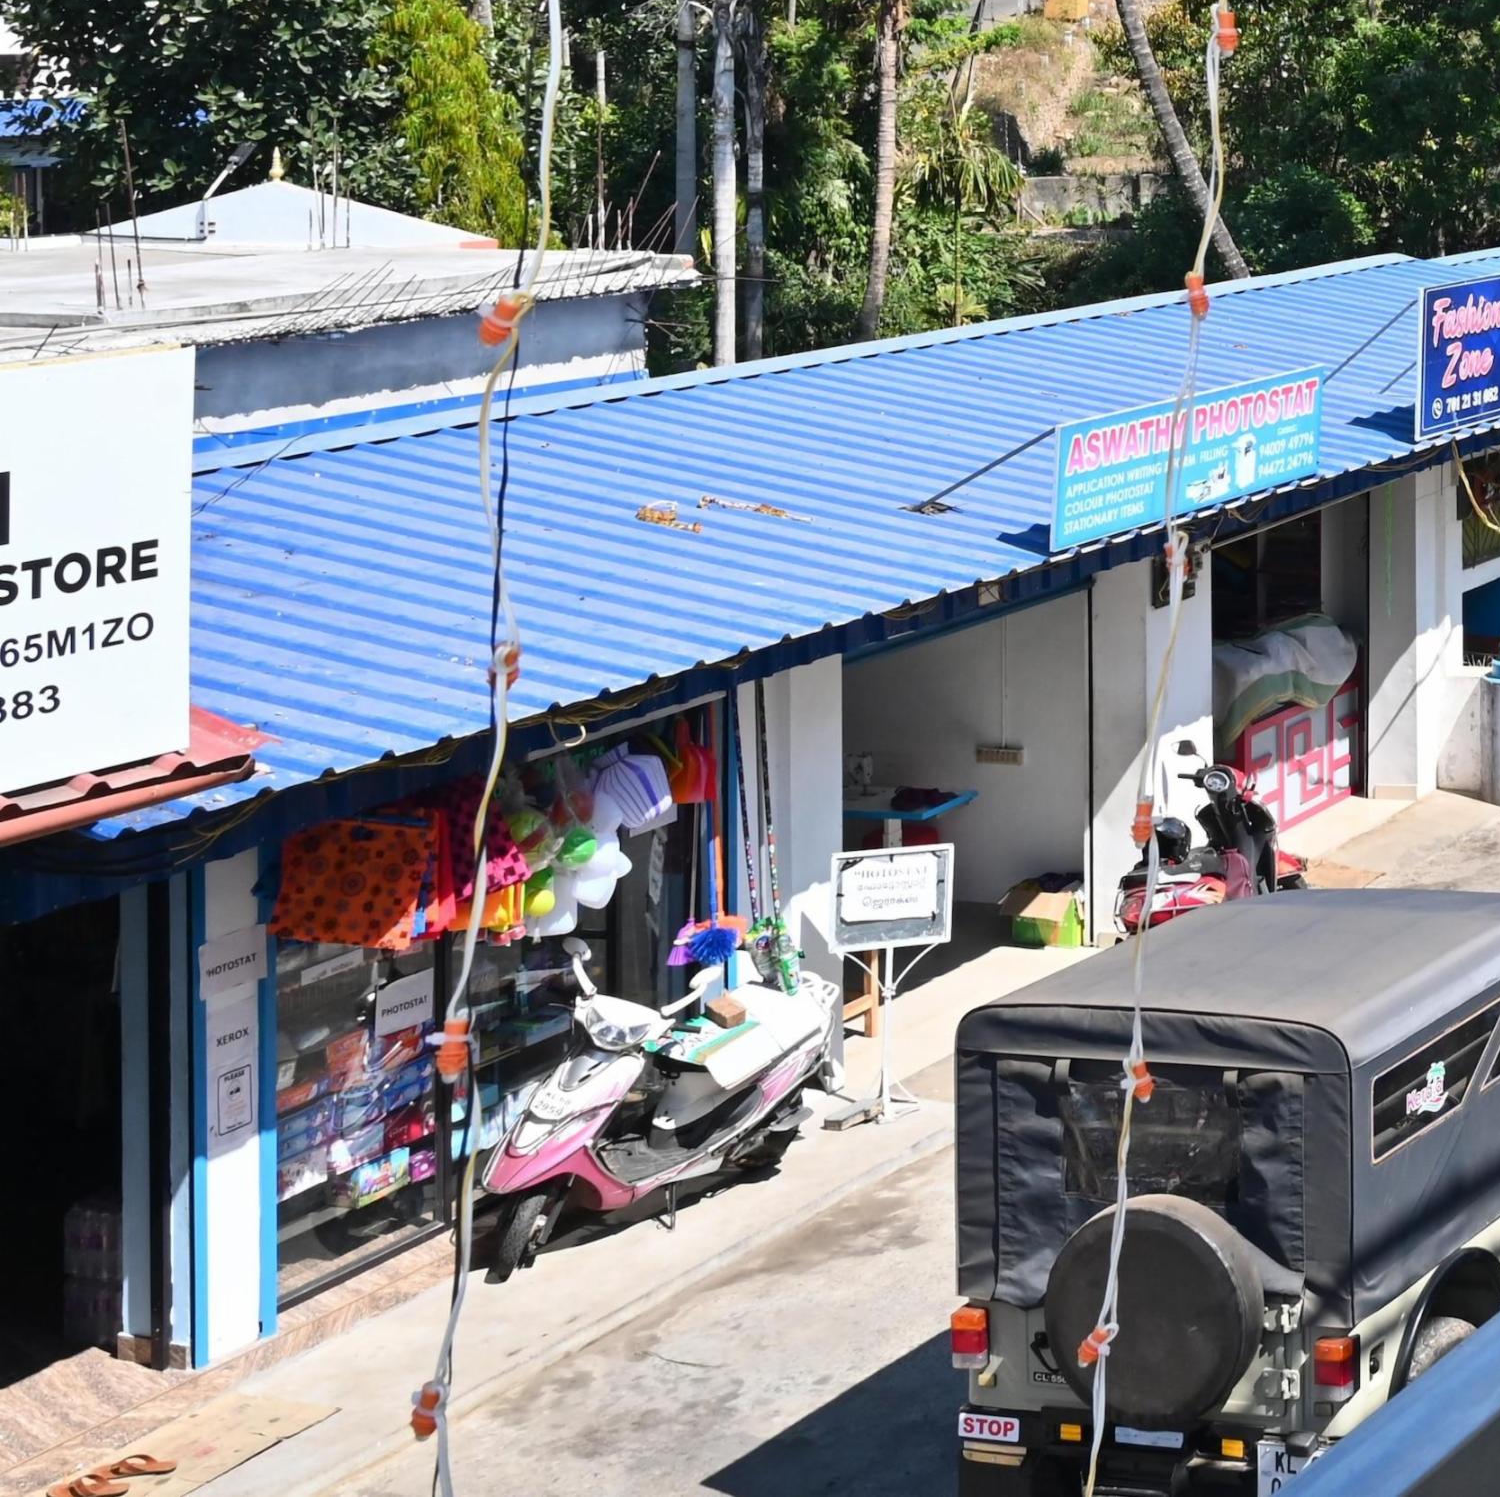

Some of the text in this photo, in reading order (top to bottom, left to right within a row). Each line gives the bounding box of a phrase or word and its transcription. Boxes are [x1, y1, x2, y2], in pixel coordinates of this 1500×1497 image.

[1442, 341, 1494, 389] Zone
[1066, 378, 1320, 477] ASWATHY PHOTOSTAT
[1065, 472, 1125, 499] APPLICATION
[1126, 461, 1163, 483] WRITING
[1199, 445, 1228, 464] FILLING
[1064, 481, 1155, 517] COLOUR PHOTOSTAT
[1063, 501, 1145, 536] STATIONARY ITEMS
[0, 539, 159, 606] STORE
[381, 995, 428, 1018] PHOTOSTAT
[216, 1027, 250, 1048] XEROX
[962, 1417, 1016, 1438] STOP
[1275, 1451, 1298, 1475] KL
